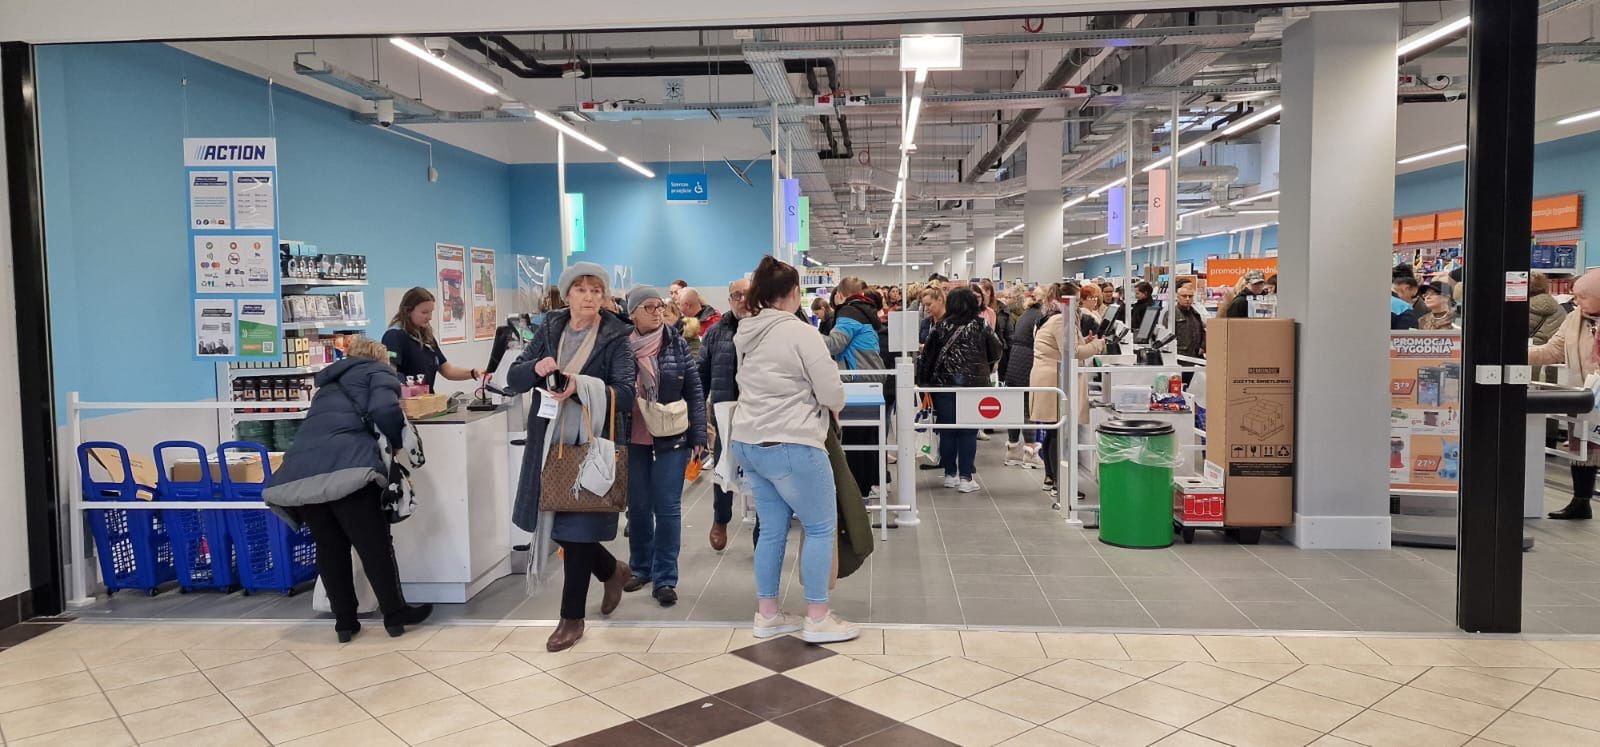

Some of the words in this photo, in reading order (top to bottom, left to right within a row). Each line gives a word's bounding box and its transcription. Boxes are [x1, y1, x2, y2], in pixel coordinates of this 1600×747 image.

[204, 145, 266, 160] ACTION
[1210, 266, 1245, 276] promocja
[1393, 338, 1453, 346] PROMOCJA
[1396, 345, 1451, 353] TYGODNIA
